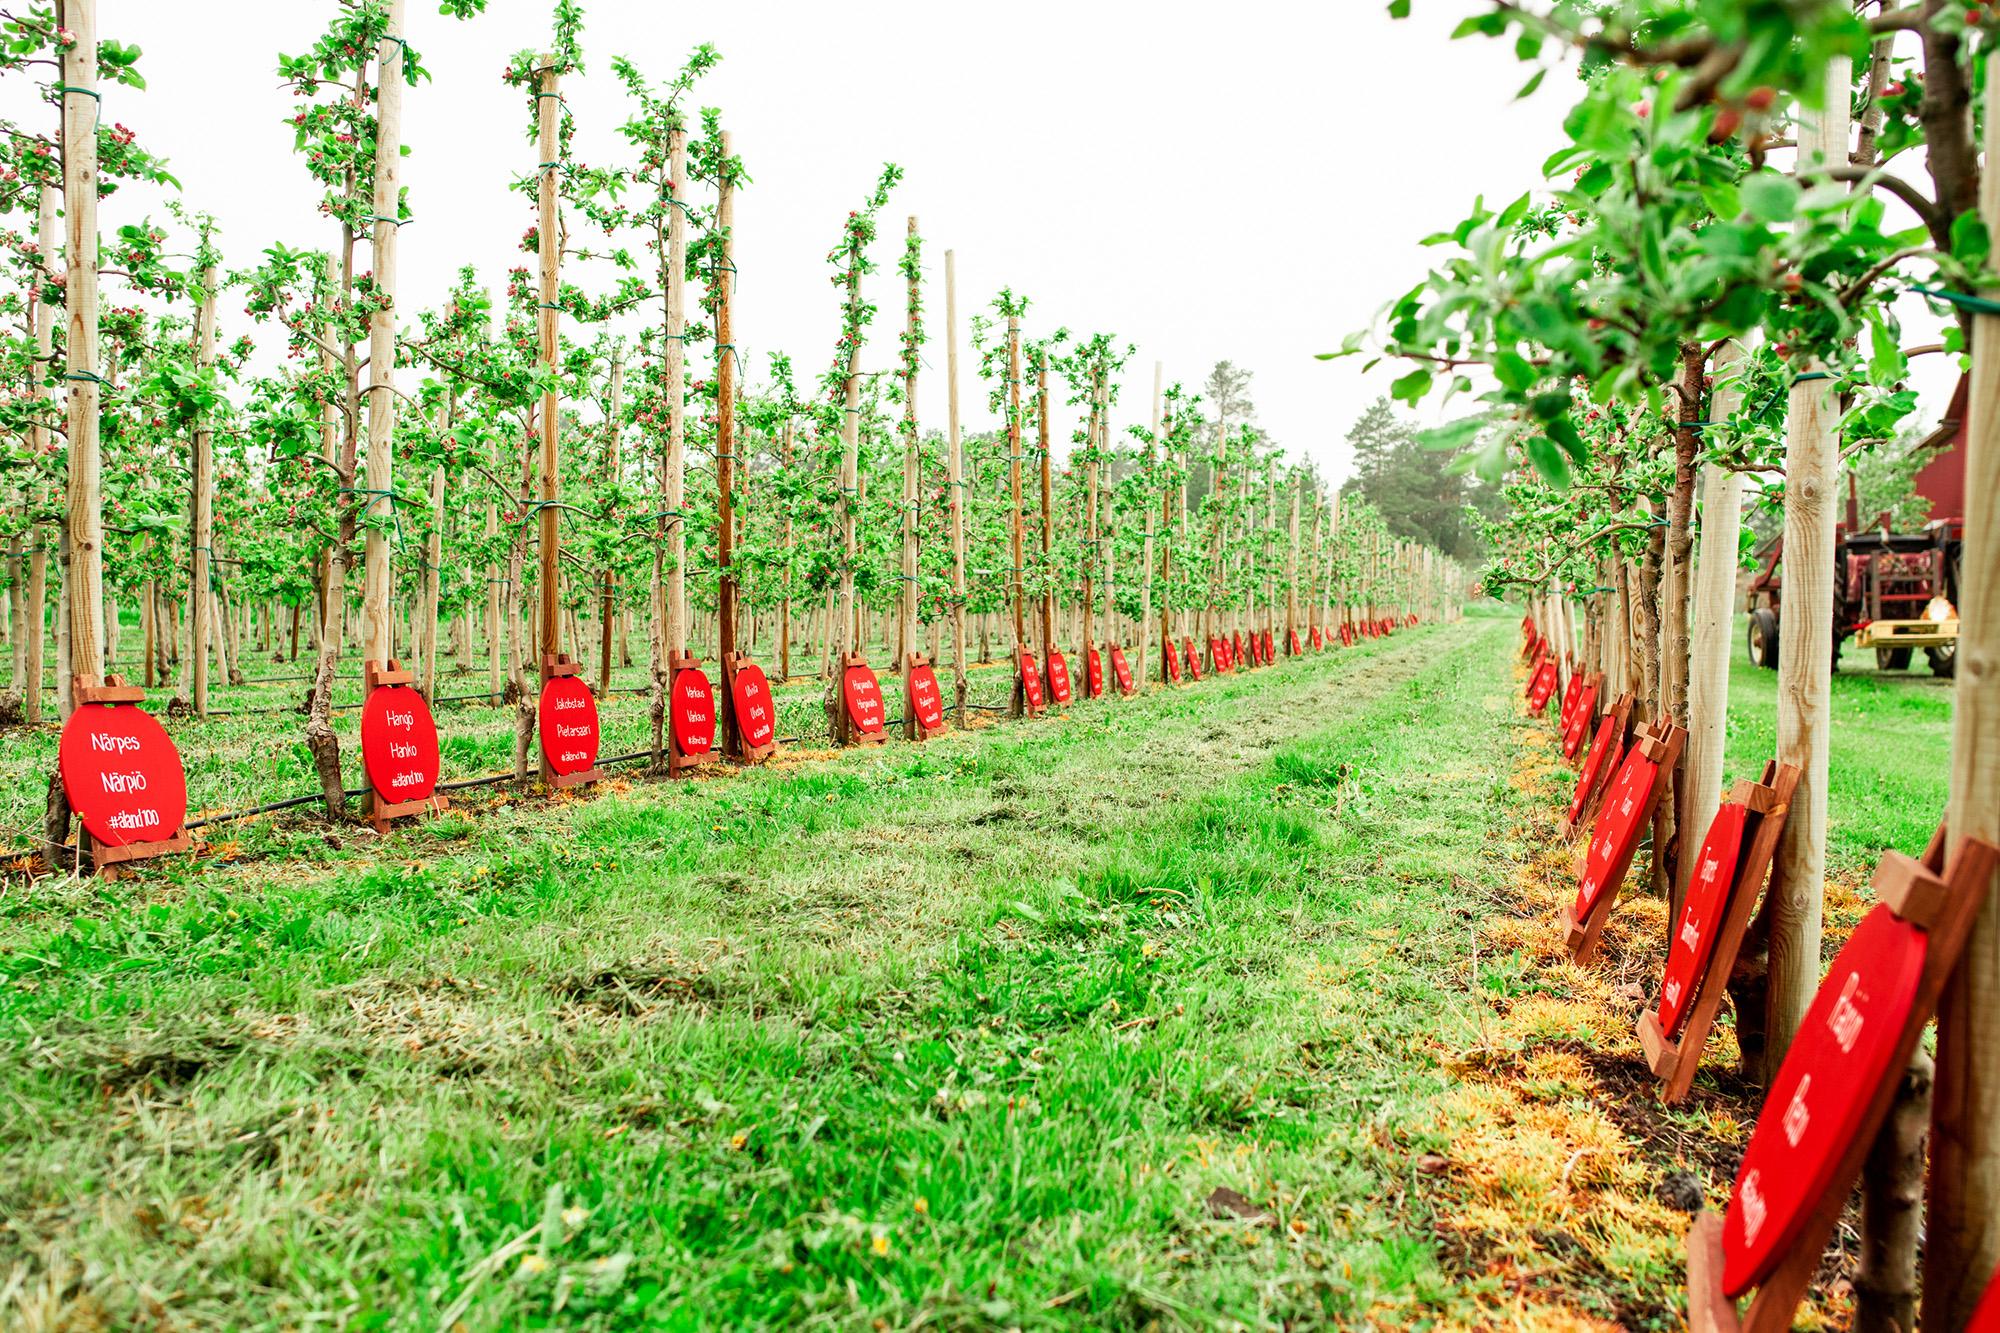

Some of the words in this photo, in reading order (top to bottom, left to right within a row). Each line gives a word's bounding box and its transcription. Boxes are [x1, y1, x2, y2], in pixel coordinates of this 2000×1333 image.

[555, 698, 585, 710] Jakobstad
[386, 710, 414, 731] Hangö
[91, 733, 140, 755] Närpes
[390, 741, 417, 758] Hanko
[101, 771, 147, 794] Närpiö
